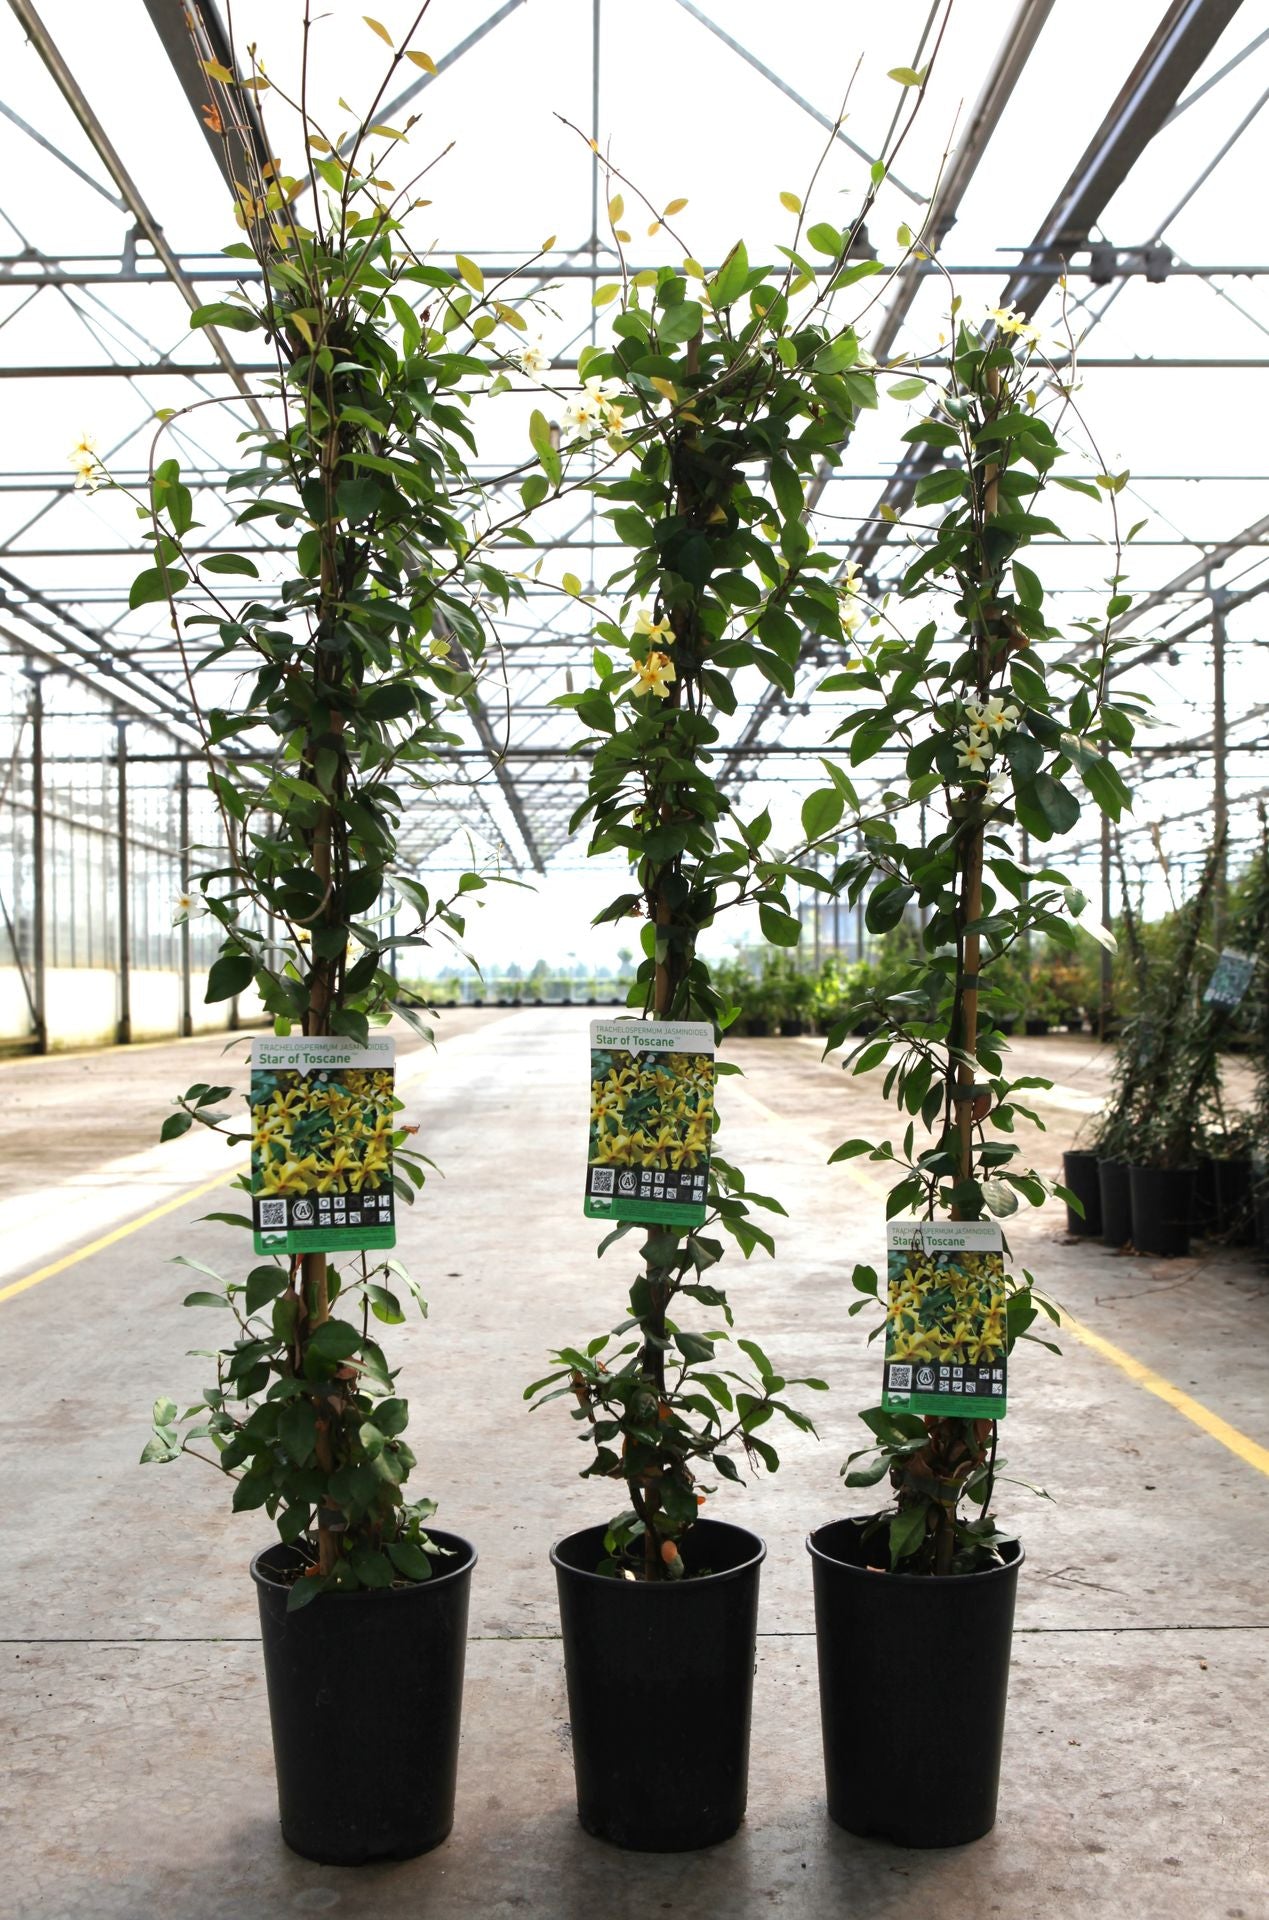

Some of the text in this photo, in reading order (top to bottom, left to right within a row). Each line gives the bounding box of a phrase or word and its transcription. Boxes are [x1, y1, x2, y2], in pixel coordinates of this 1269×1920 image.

[596, 1025, 708, 1037] TRACHELOSPERMUM JASMINOIDES
[596, 1034, 675, 1047] Star of Toscane
[259, 1042, 389, 1052] TRACHELOSPERMUM JASMIOIDES
[259, 1053, 351, 1064] Star of Toscane
[892, 1236, 912, 1246] Star
[927, 1236, 965, 1246] Toscane
